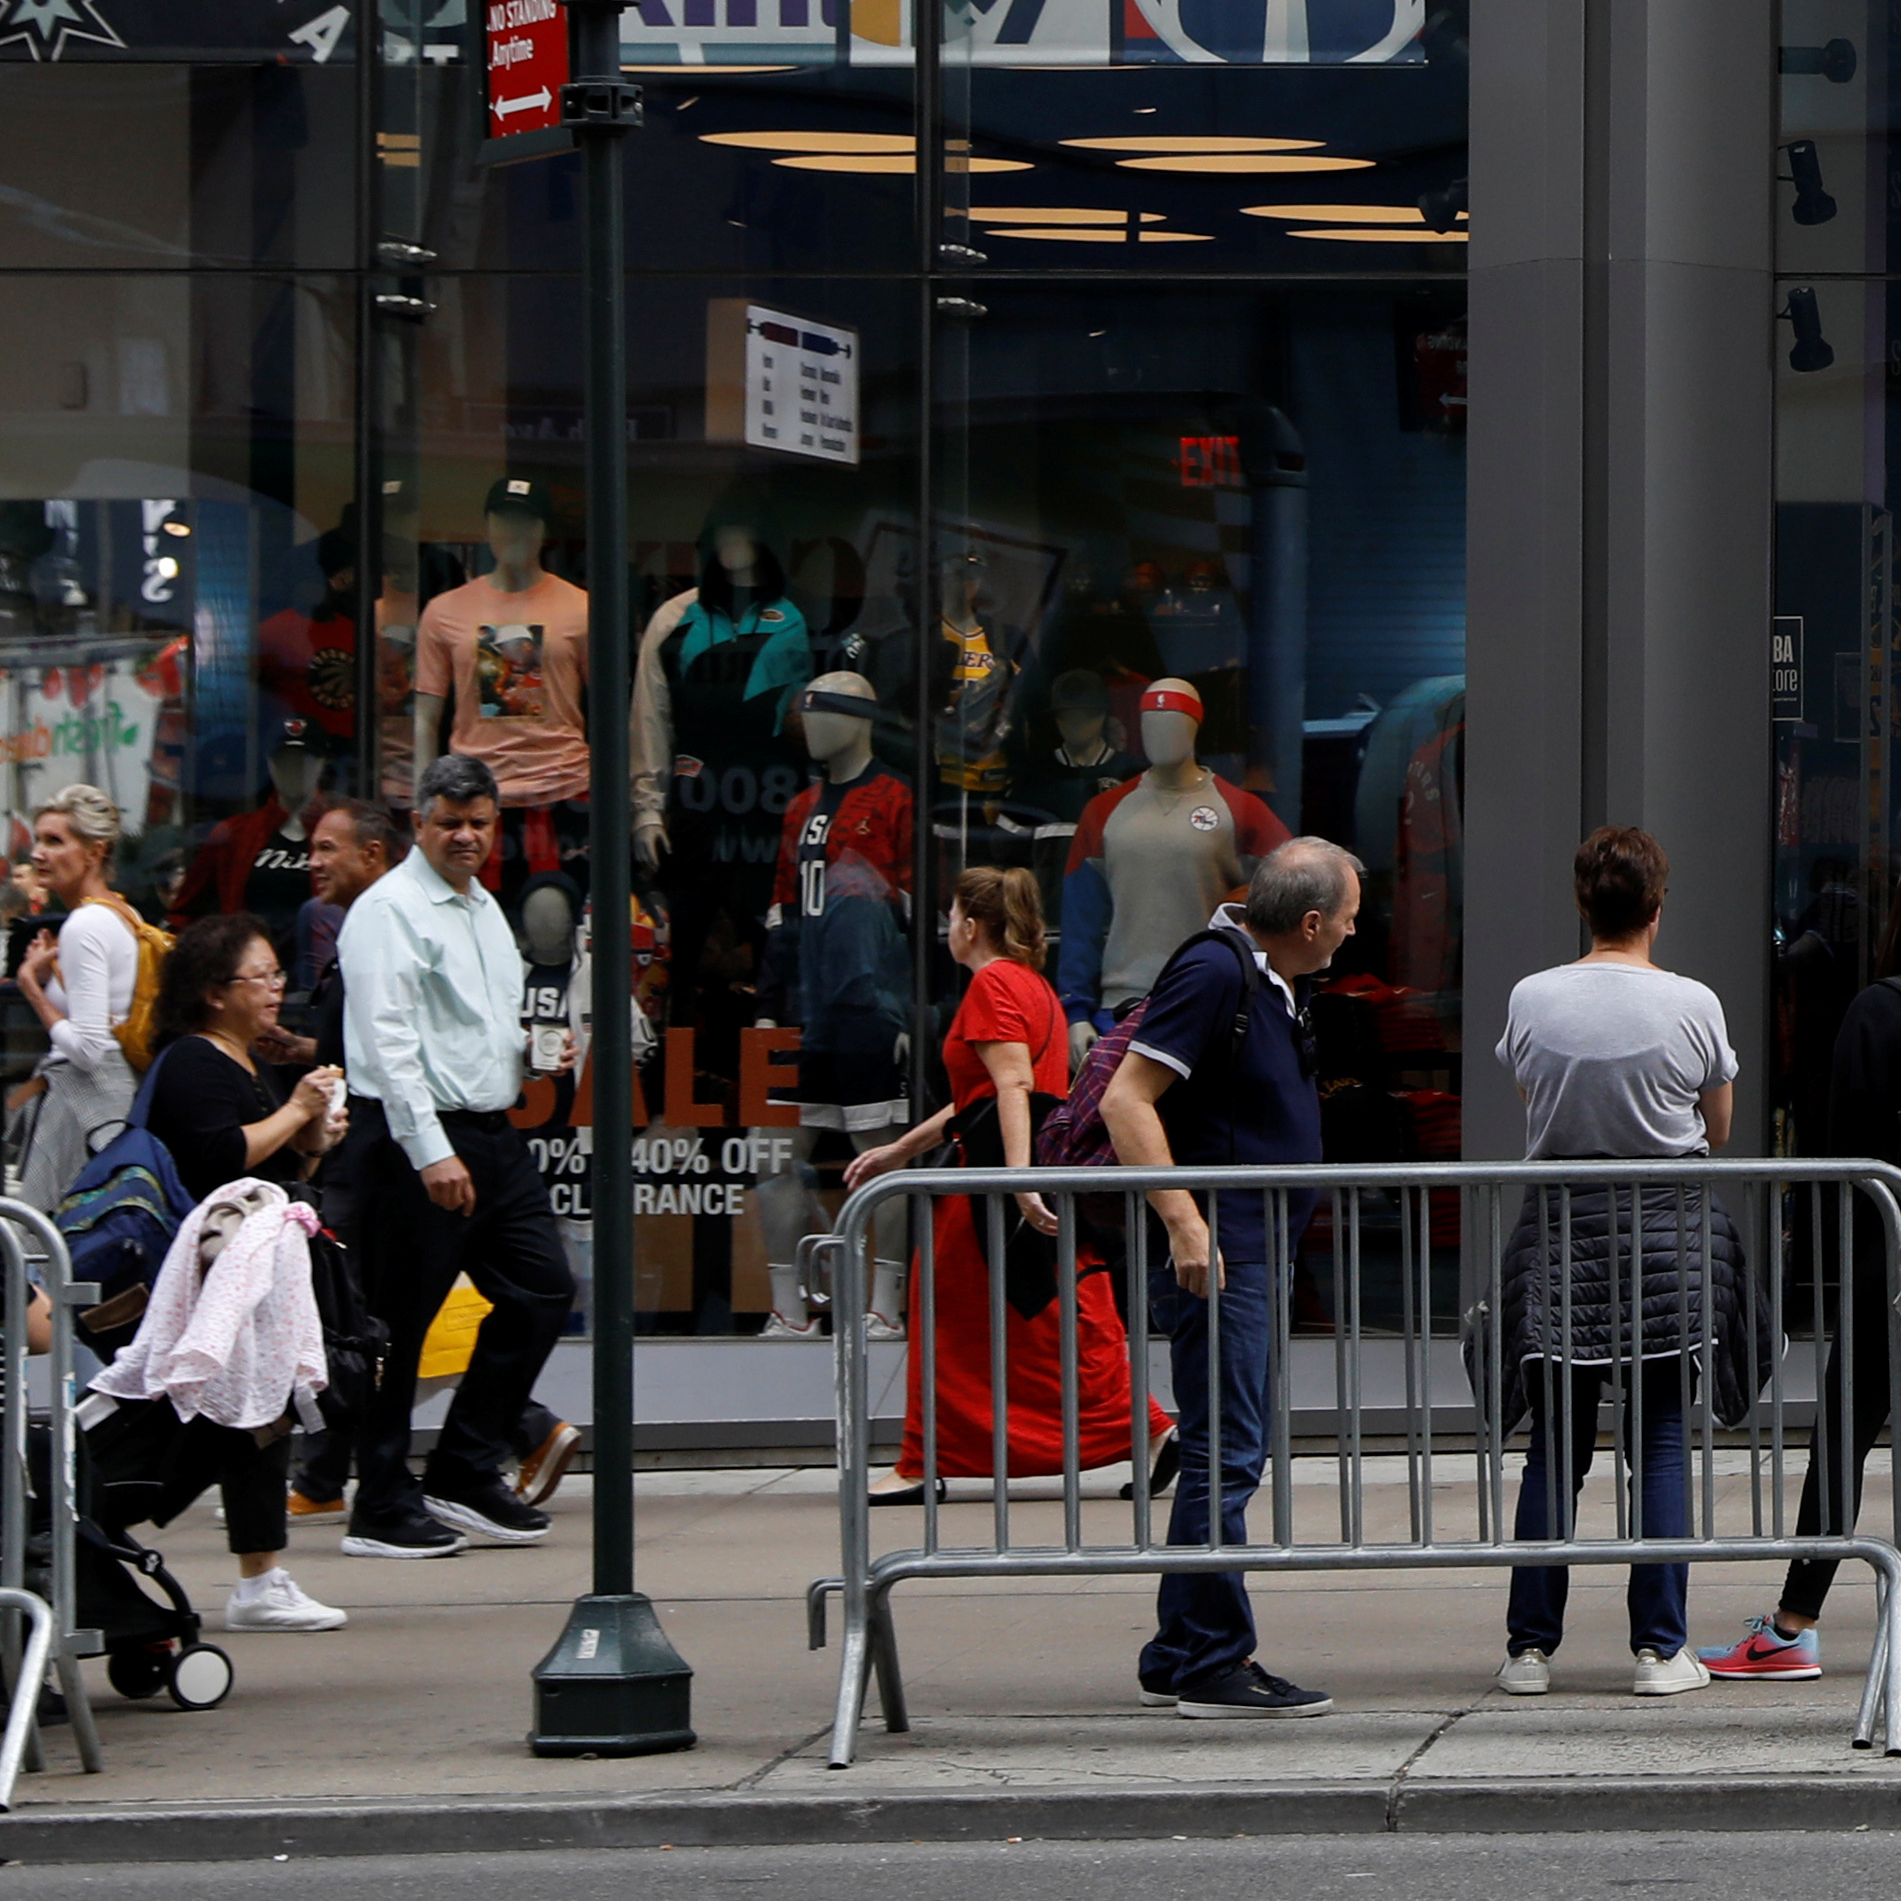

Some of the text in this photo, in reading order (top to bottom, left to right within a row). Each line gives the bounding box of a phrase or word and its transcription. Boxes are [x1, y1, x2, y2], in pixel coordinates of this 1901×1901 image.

[490, 2, 506, 32] NO
[491, 34, 534, 71] Anytime
[721, 1137, 794, 1176] OFF
[550, 1182, 745, 1216] CLRANCE
